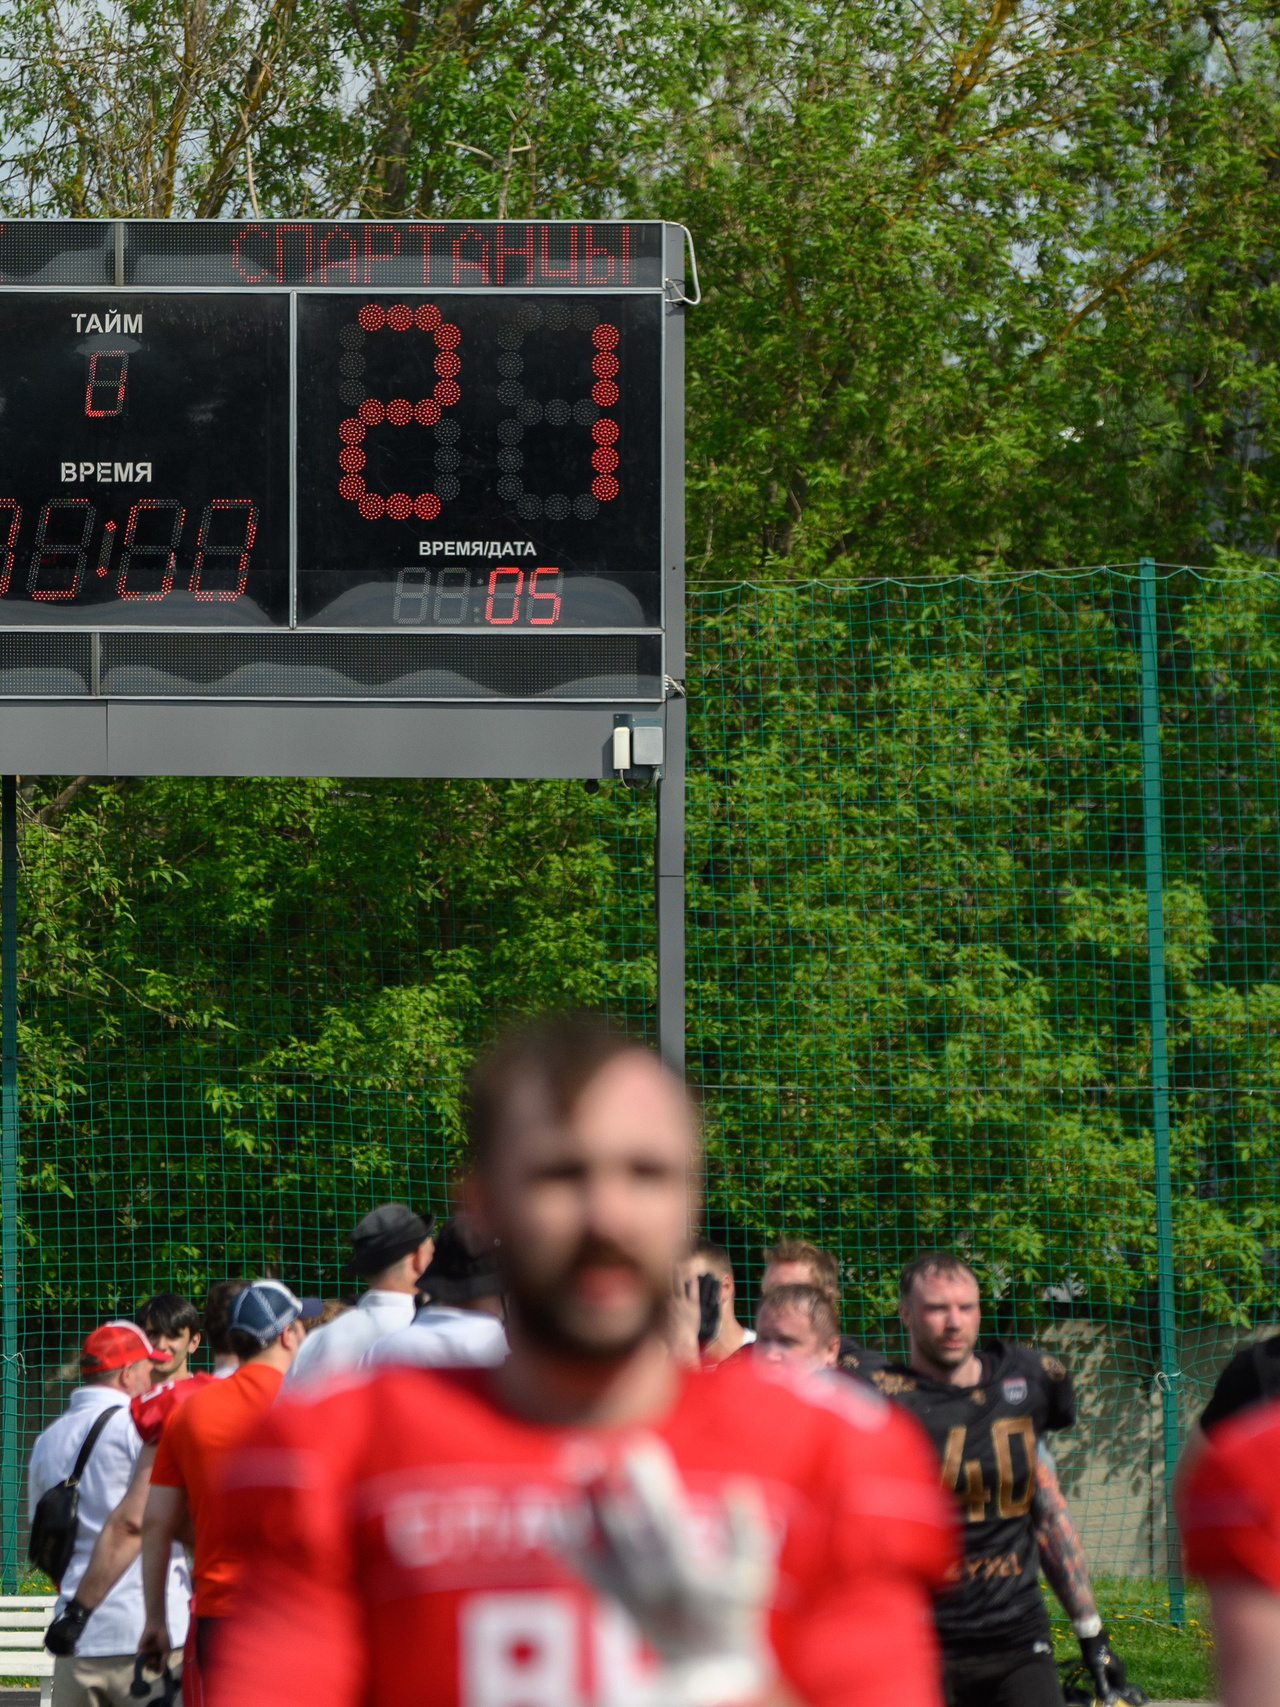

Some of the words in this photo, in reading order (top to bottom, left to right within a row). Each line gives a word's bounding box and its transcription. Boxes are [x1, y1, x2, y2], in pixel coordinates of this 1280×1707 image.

[232, 224, 630, 285] СПАРТАНЦЫ
[71, 309, 143, 333] ТАЙМ
[339, 304, 619, 520] 21
[61, 462, 152, 482] ВРЕМЯ
[419, 541, 537, 558] ВРЕМЯ/ДАТА
[941, 1416, 1035, 1522] 40
